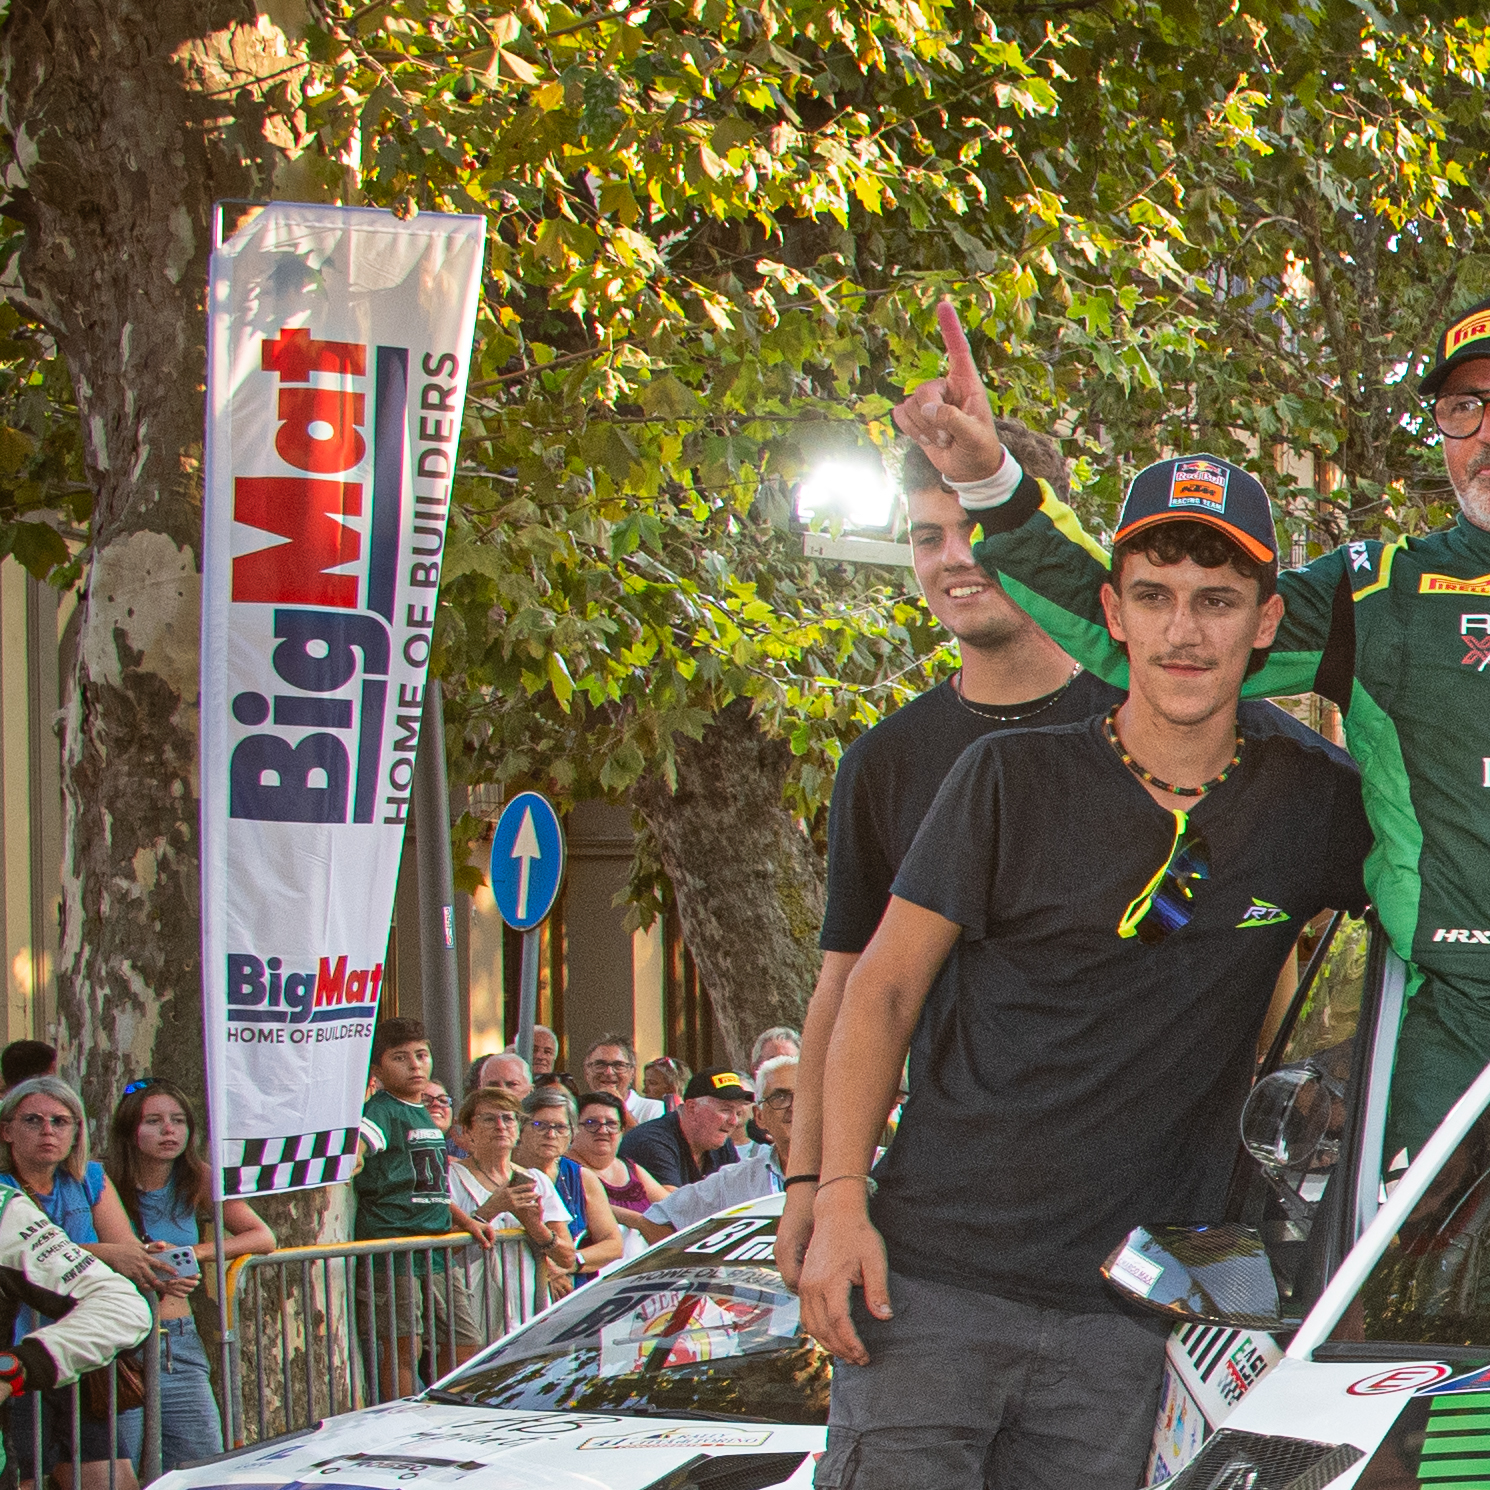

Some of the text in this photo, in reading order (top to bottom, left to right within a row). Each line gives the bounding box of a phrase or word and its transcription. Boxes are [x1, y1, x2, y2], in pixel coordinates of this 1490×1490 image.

[1202, 471, 1225, 488] Bull
[1172, 496, 1222, 511] RACING TEAM
[230, 328, 392, 823] BigMat
[384, 352, 460, 825] HOME OF BUILDERS
[227, 953, 383, 1023] BigMat
[227, 1023, 373, 1043] HOME OF BUILDERS
